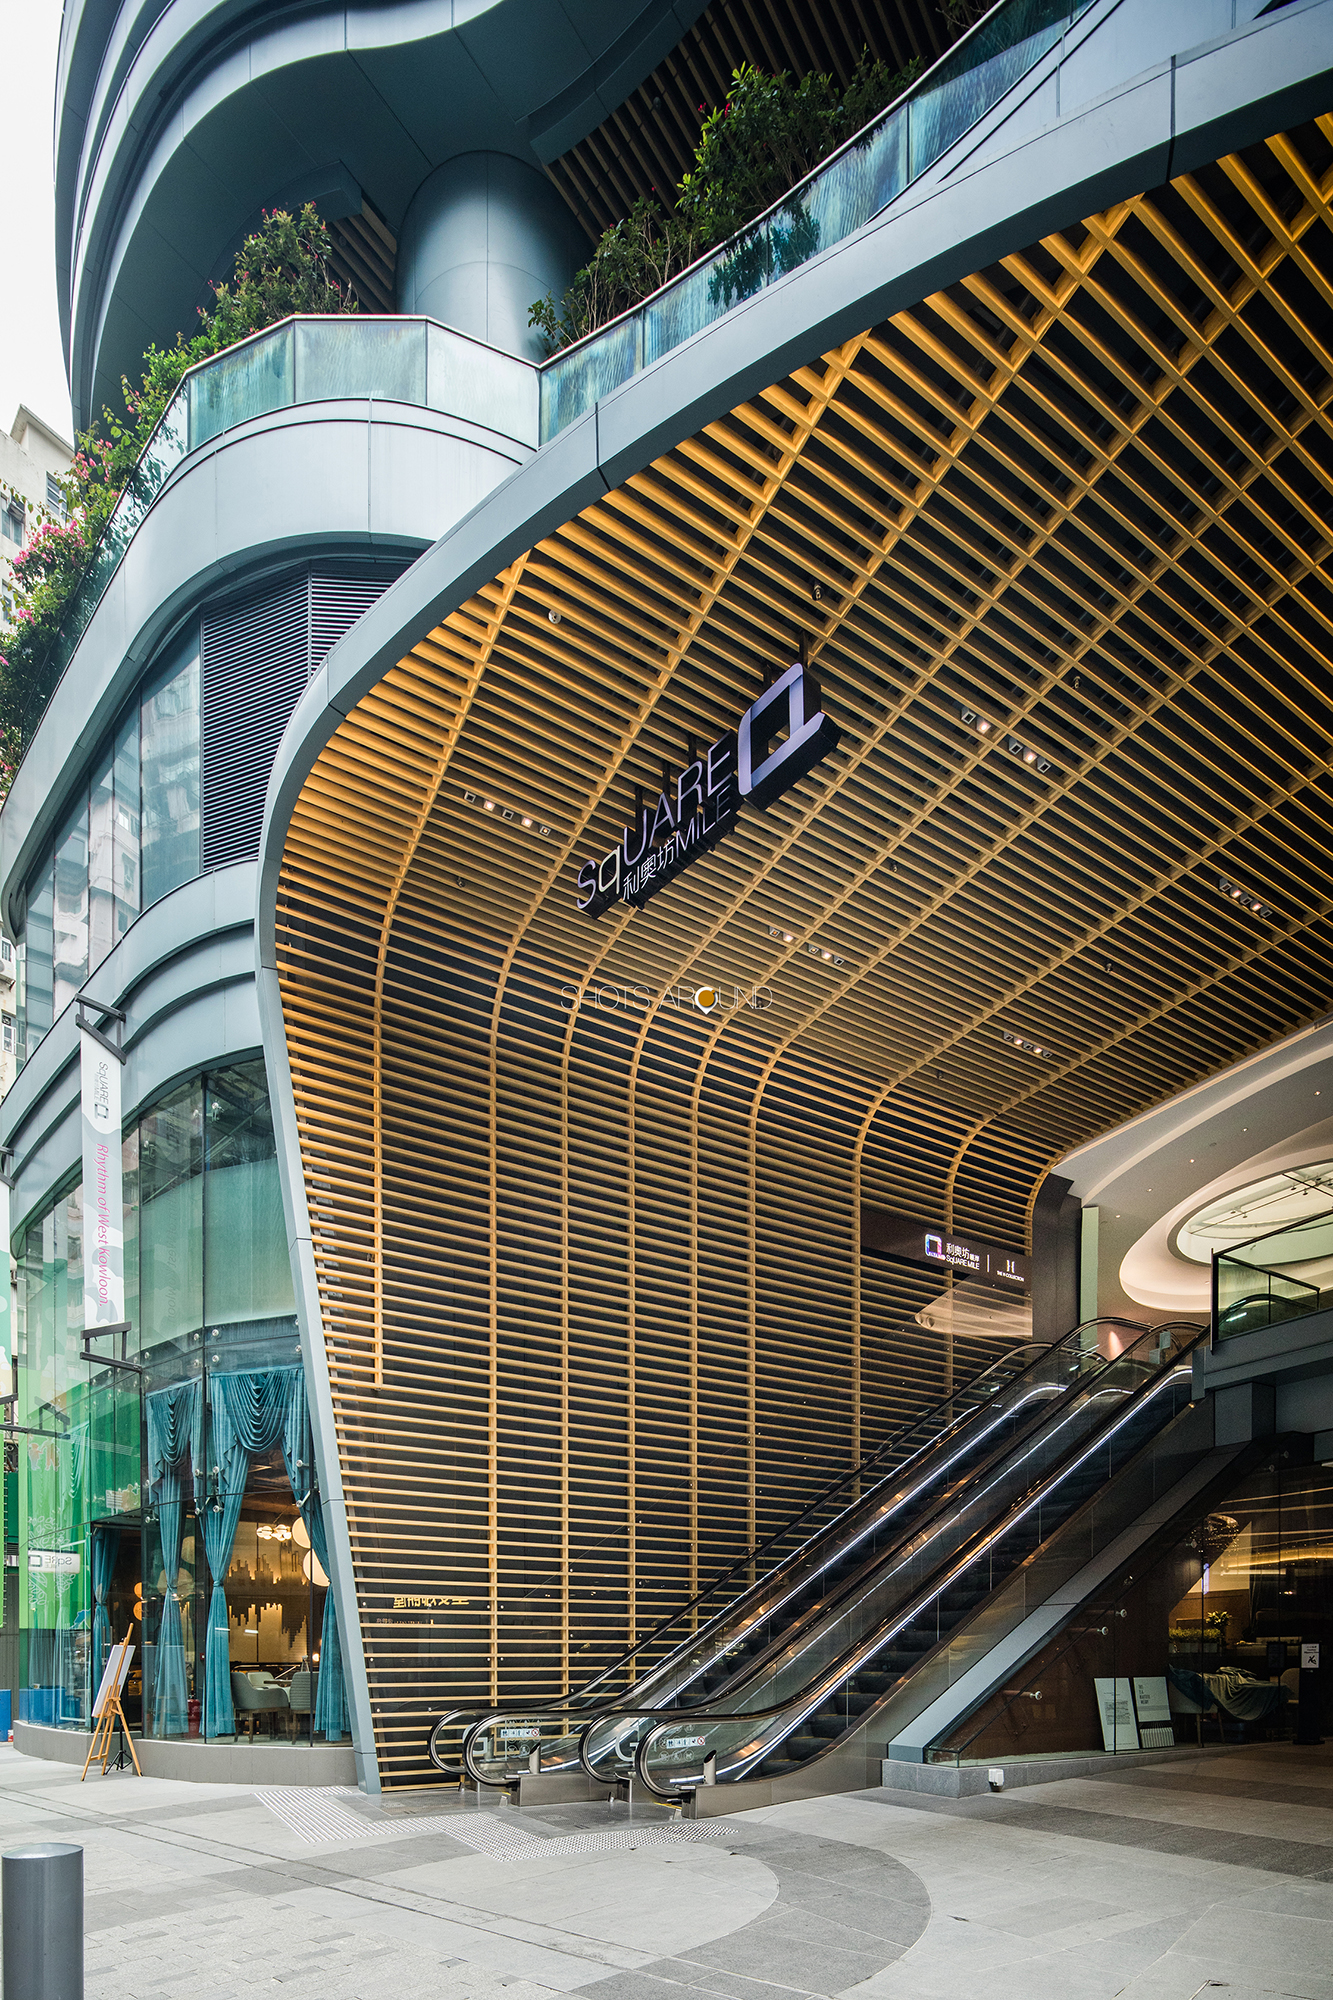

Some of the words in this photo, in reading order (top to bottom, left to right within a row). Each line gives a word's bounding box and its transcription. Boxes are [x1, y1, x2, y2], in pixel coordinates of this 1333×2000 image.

[676, 784, 731, 858] MILE
[94, 1143, 110, 1194] Rhythm
[97, 1197, 111, 1213] of
[98, 1214, 111, 1246] West
[98, 1247, 112, 1308] Kowloon.
